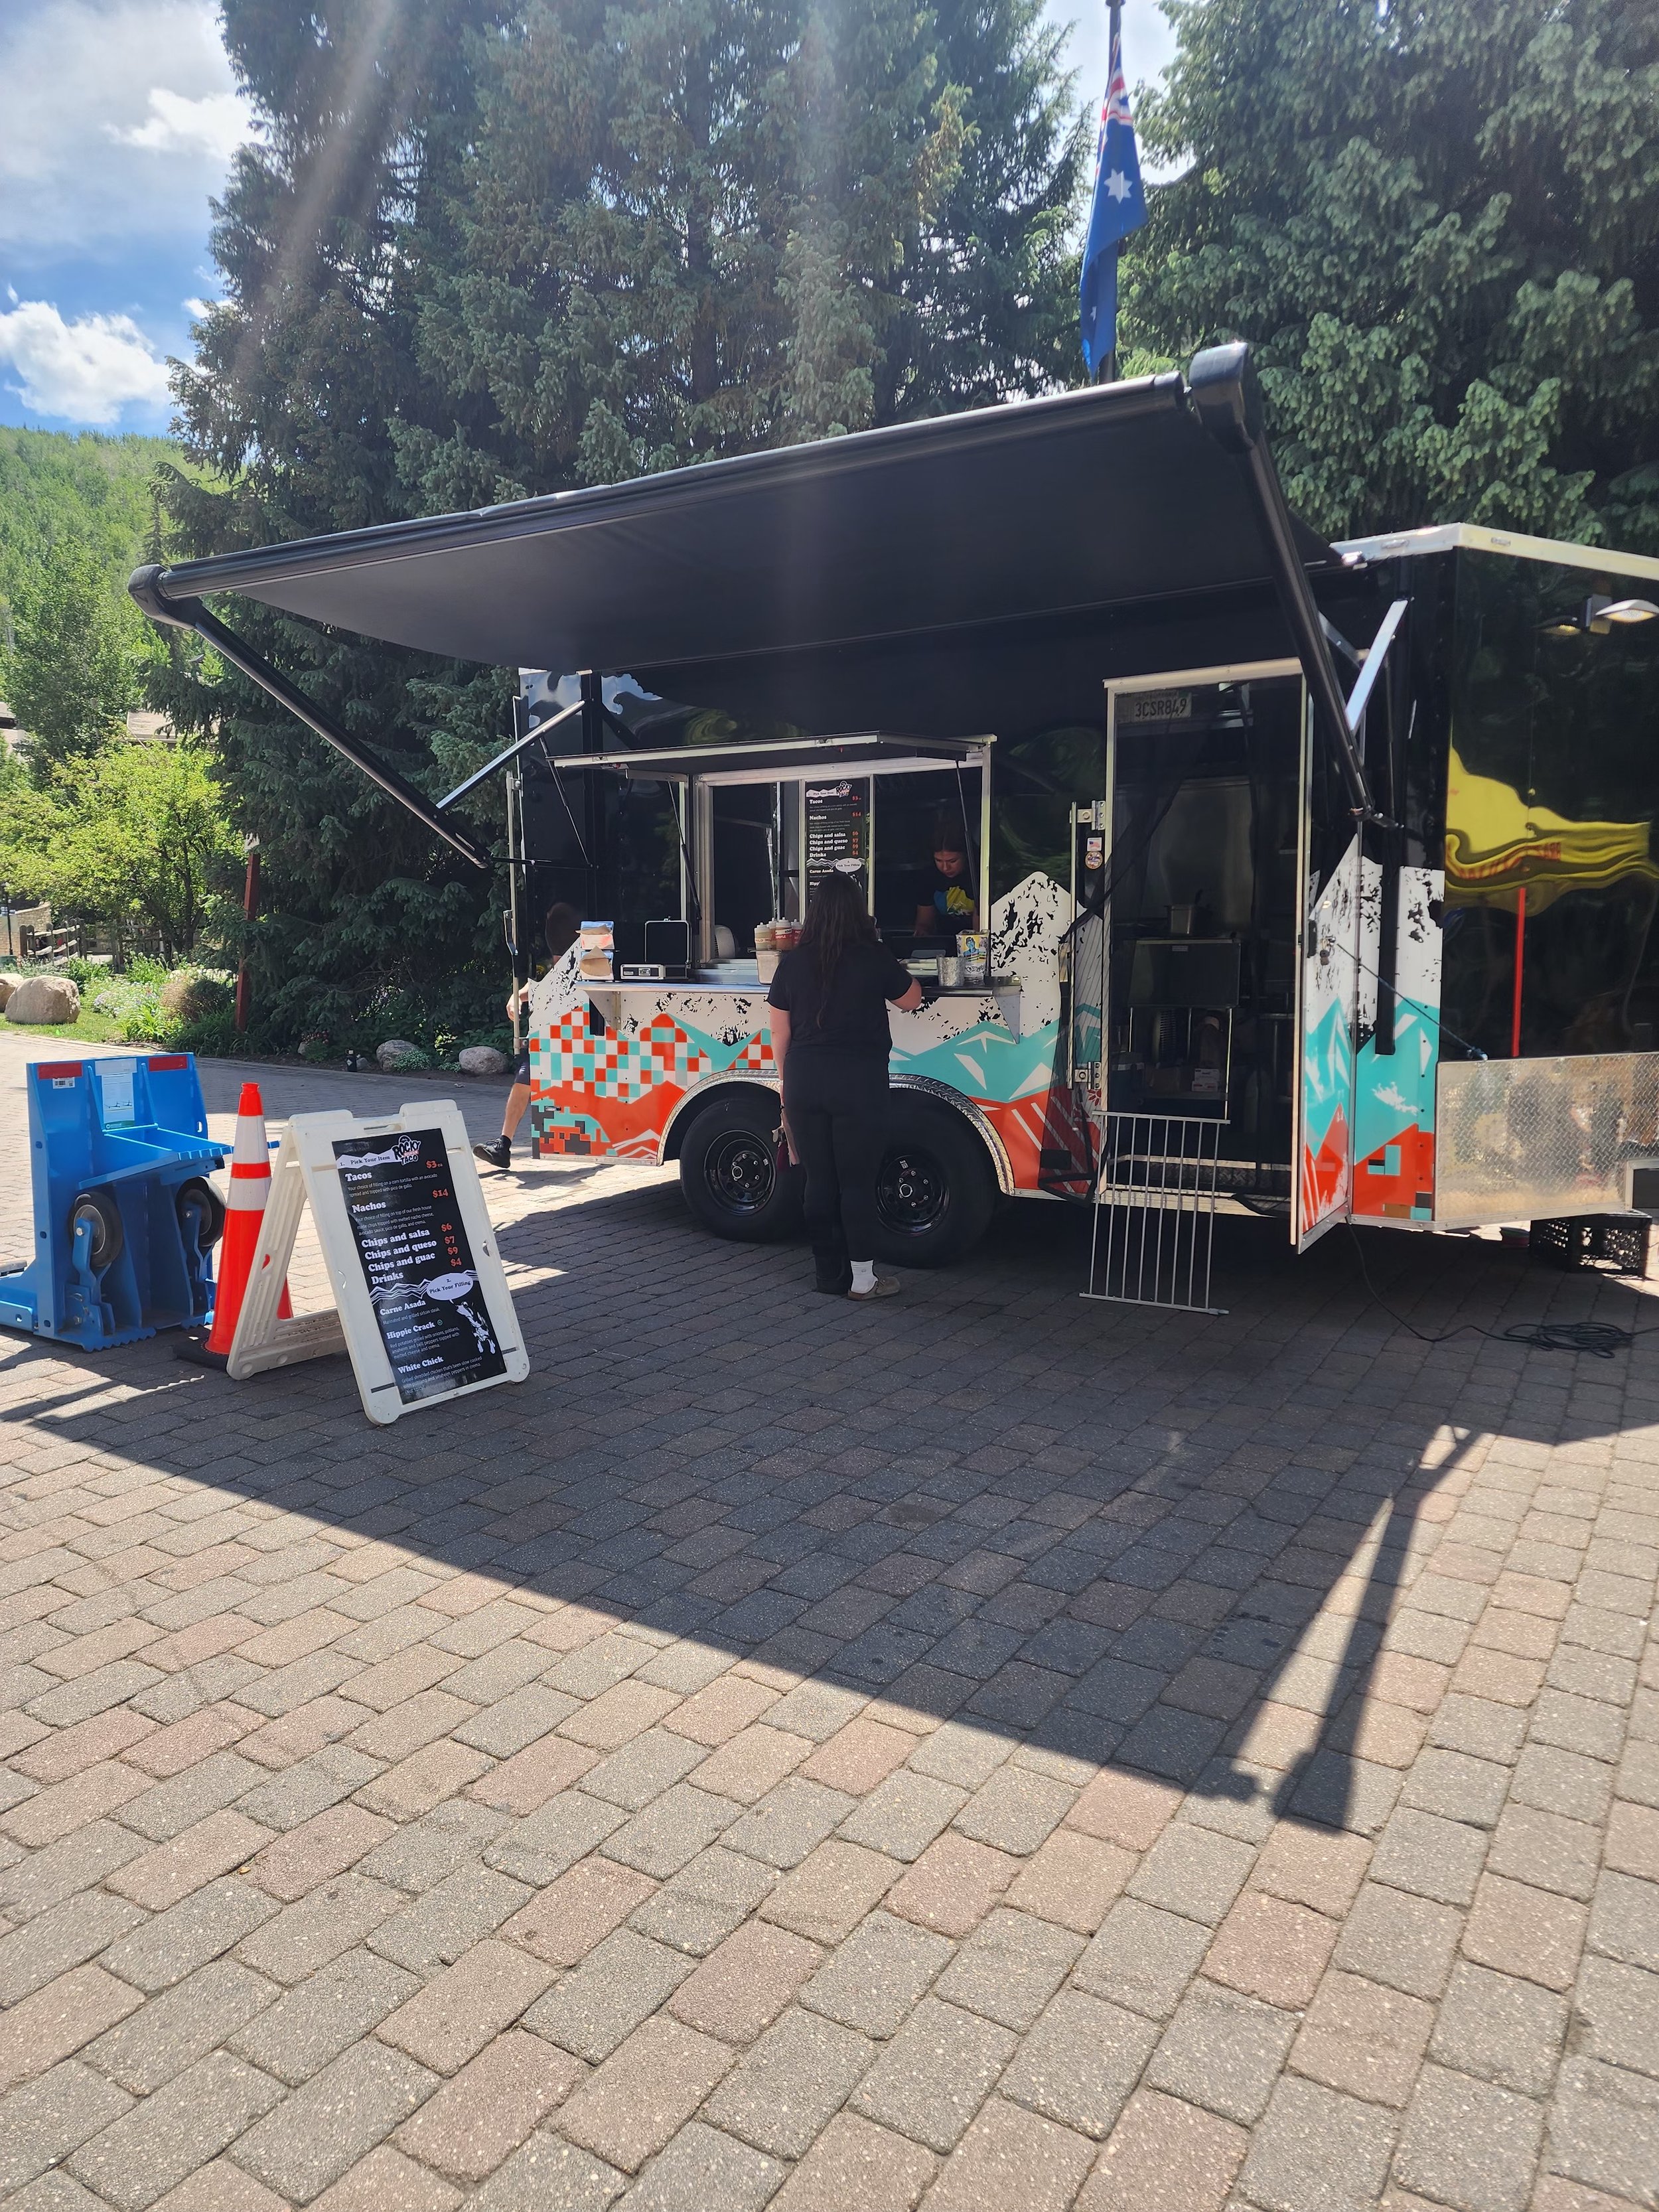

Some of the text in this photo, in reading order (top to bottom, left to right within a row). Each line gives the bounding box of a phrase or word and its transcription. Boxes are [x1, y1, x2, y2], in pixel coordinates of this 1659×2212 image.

[392, 1141, 420, 1160] ROCKY
[401, 1155, 418, 1165] TACO
[345, 1172, 372, 1181] Tacos
[352, 1188, 448, 1213] Nachos $14
[361, 1223, 452, 1248] Chips and salsa $6
[365, 1236, 454, 1260] Chips and queso $7
[368, 1247, 458, 1272] Chips and guac $9
[371, 1258, 462, 1284] Drinks $4
[380, 1300, 426, 1315] Carne Asada
[386, 1322, 435, 1339] Hippie Crack
[397, 1356, 444, 1373] White Chick
